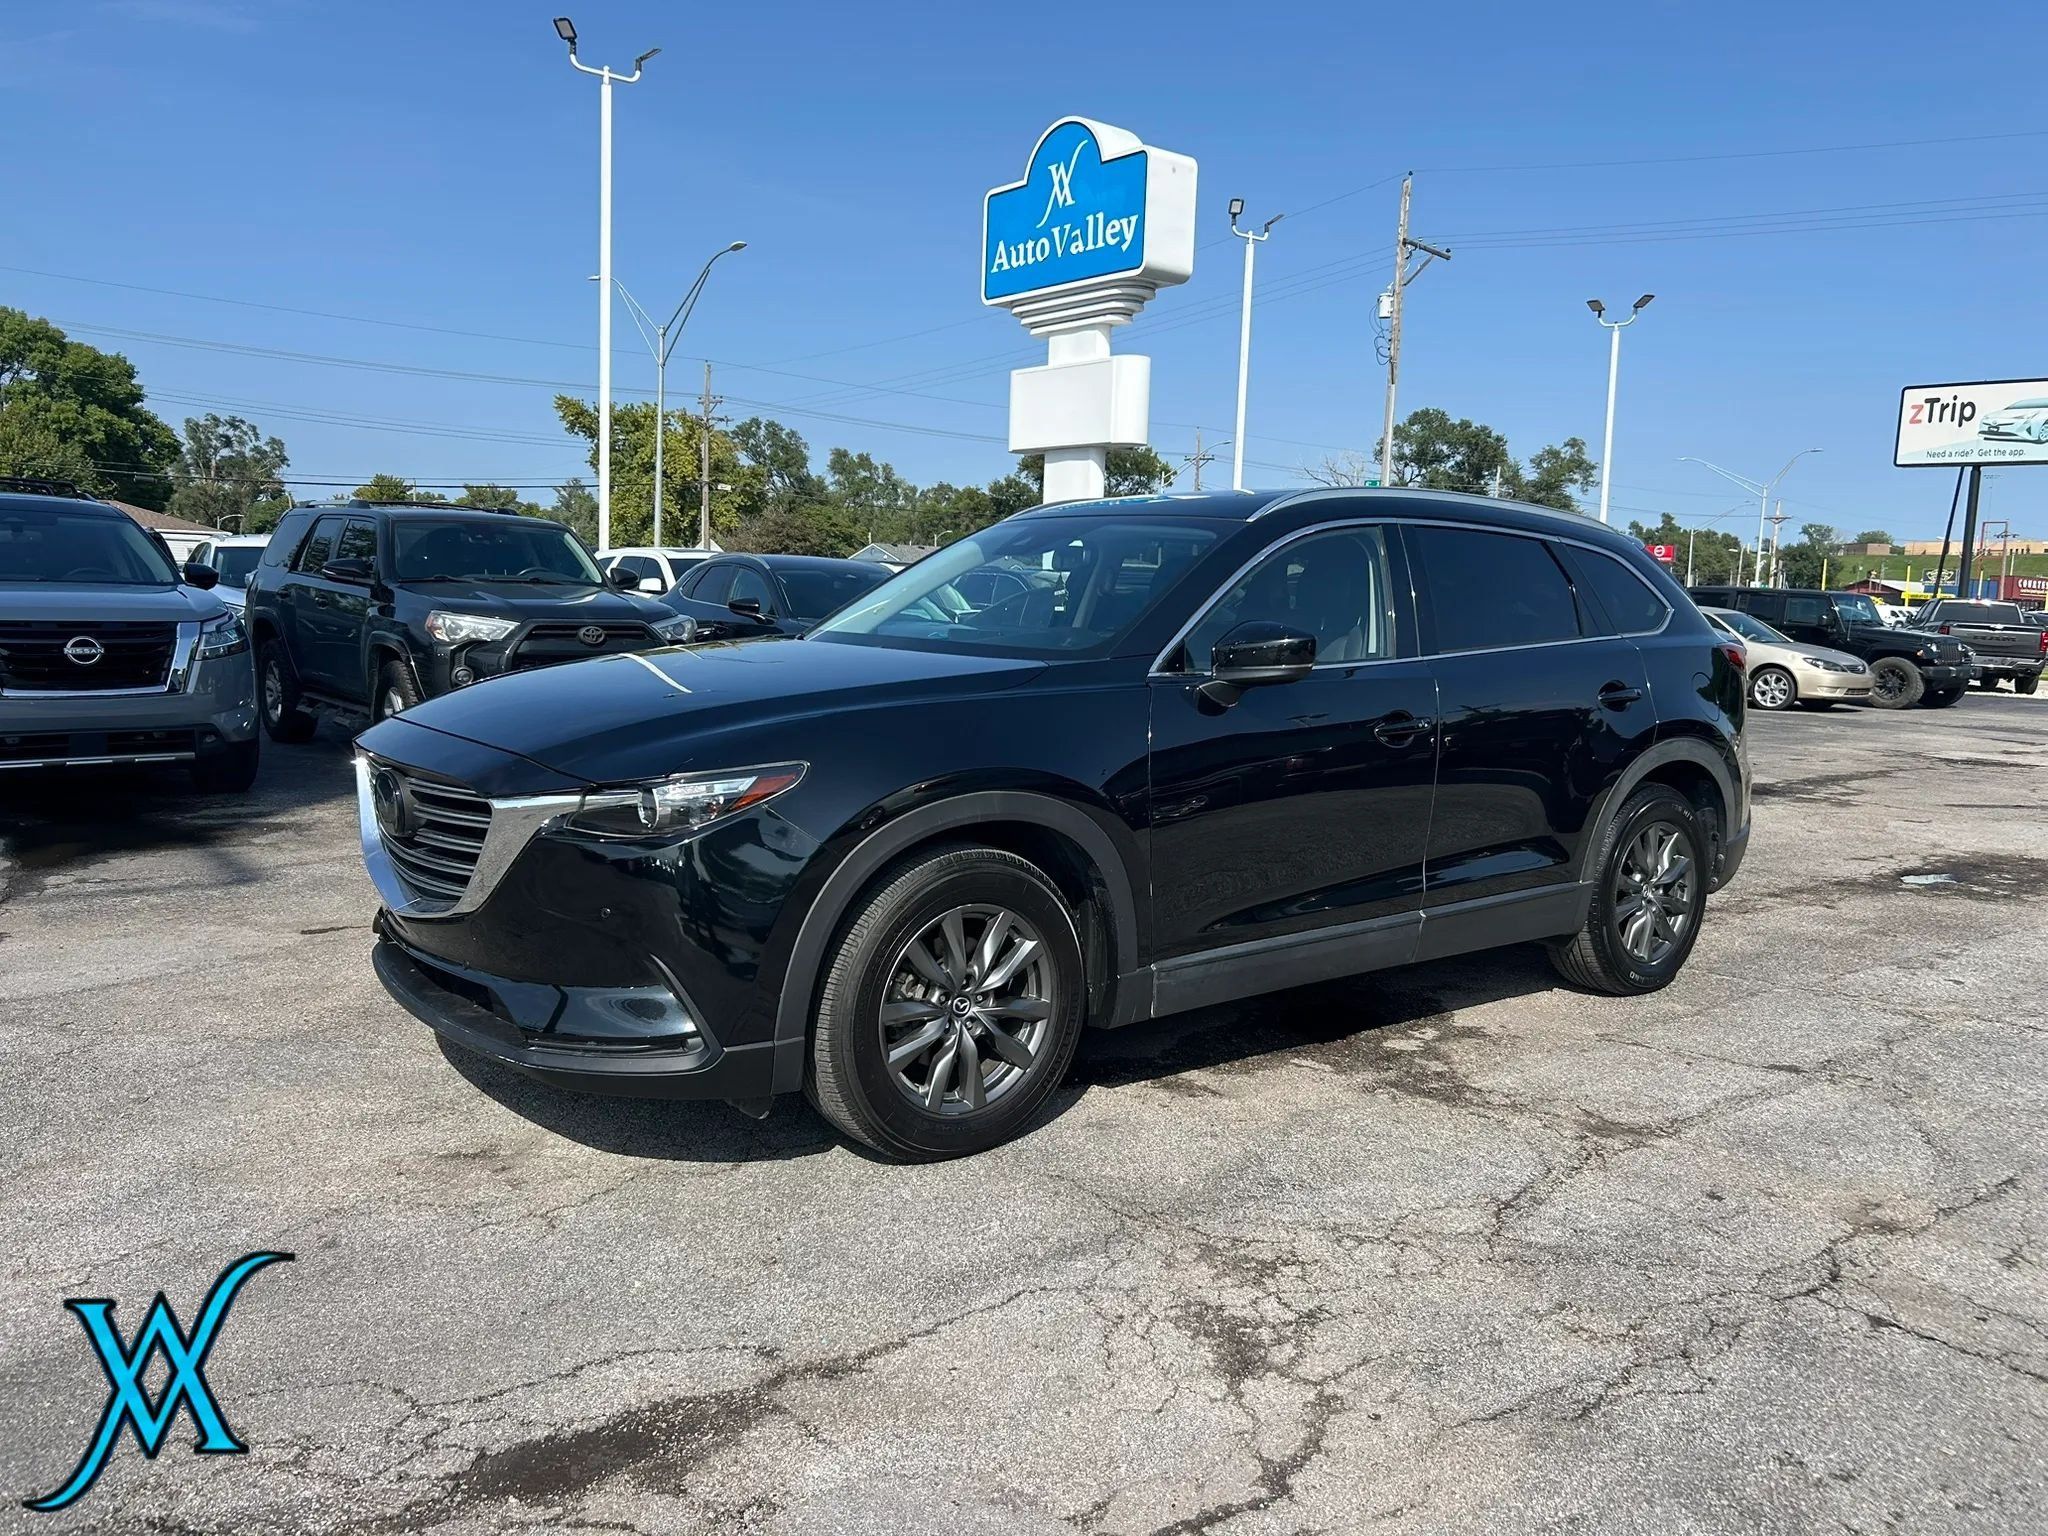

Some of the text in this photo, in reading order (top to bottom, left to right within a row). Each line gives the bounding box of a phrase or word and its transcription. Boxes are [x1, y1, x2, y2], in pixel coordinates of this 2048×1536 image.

[1909, 395, 1976, 428] zTrip
[1926, 450, 1946, 459] Need
[1954, 449, 1974, 458] ride?
[1977, 448, 1992, 457] Get
[1993, 448, 2007, 456] the
[2008, 449, 2026, 457] app.
